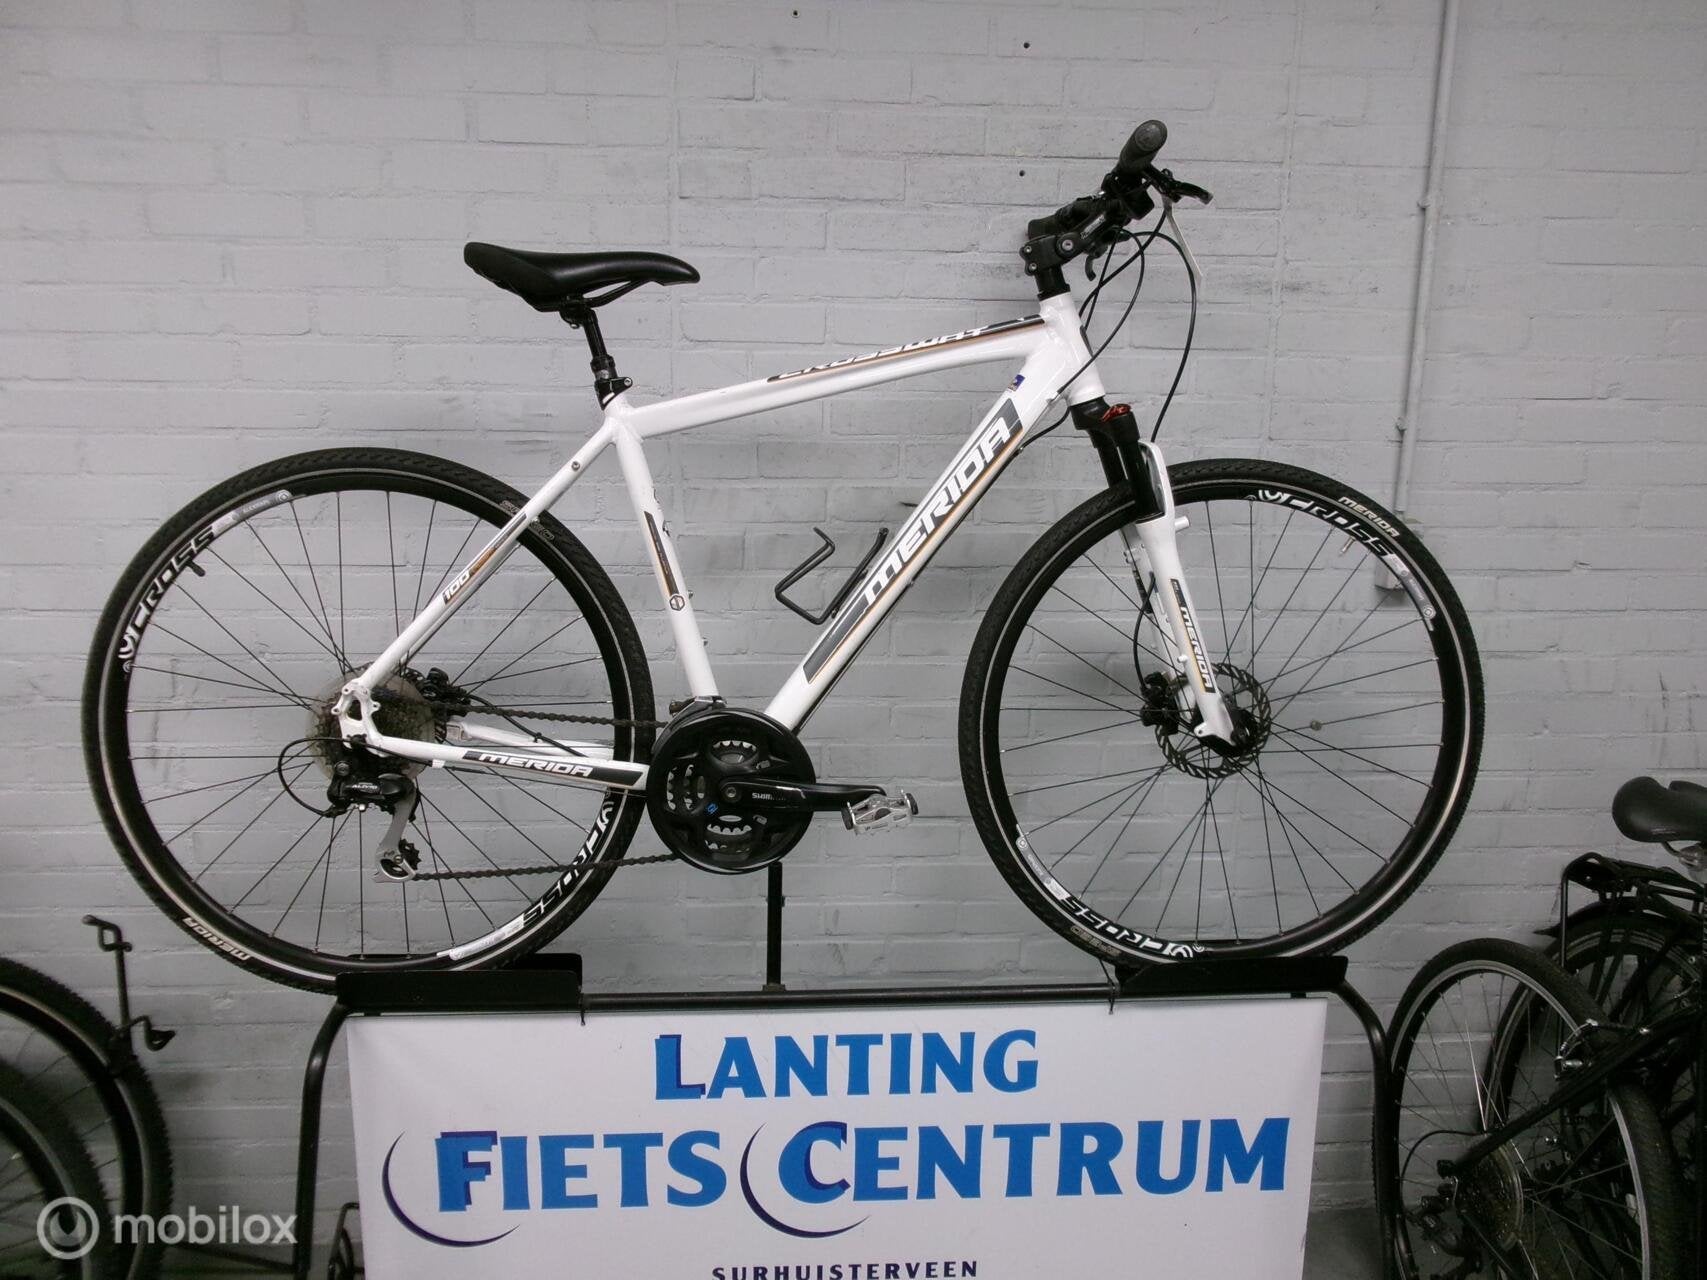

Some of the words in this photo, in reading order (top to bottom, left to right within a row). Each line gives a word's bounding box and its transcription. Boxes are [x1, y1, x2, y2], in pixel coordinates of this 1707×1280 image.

[863, 415, 1013, 606] MERIDA
[1338, 495, 1400, 537] MERIDA
[441, 569, 470, 601] 100
[1180, 606, 1214, 689] MERIDA
[477, 752, 594, 777] MERIDA
[182, 916, 251, 960] MERIDA
[655, 1029, 1039, 1100] LANTING
[435, 1130, 728, 1212] FIETS
[778, 1117, 1290, 1204] CENTRUM
[712, 1260, 978, 1280] SURHUISTERVEEN
